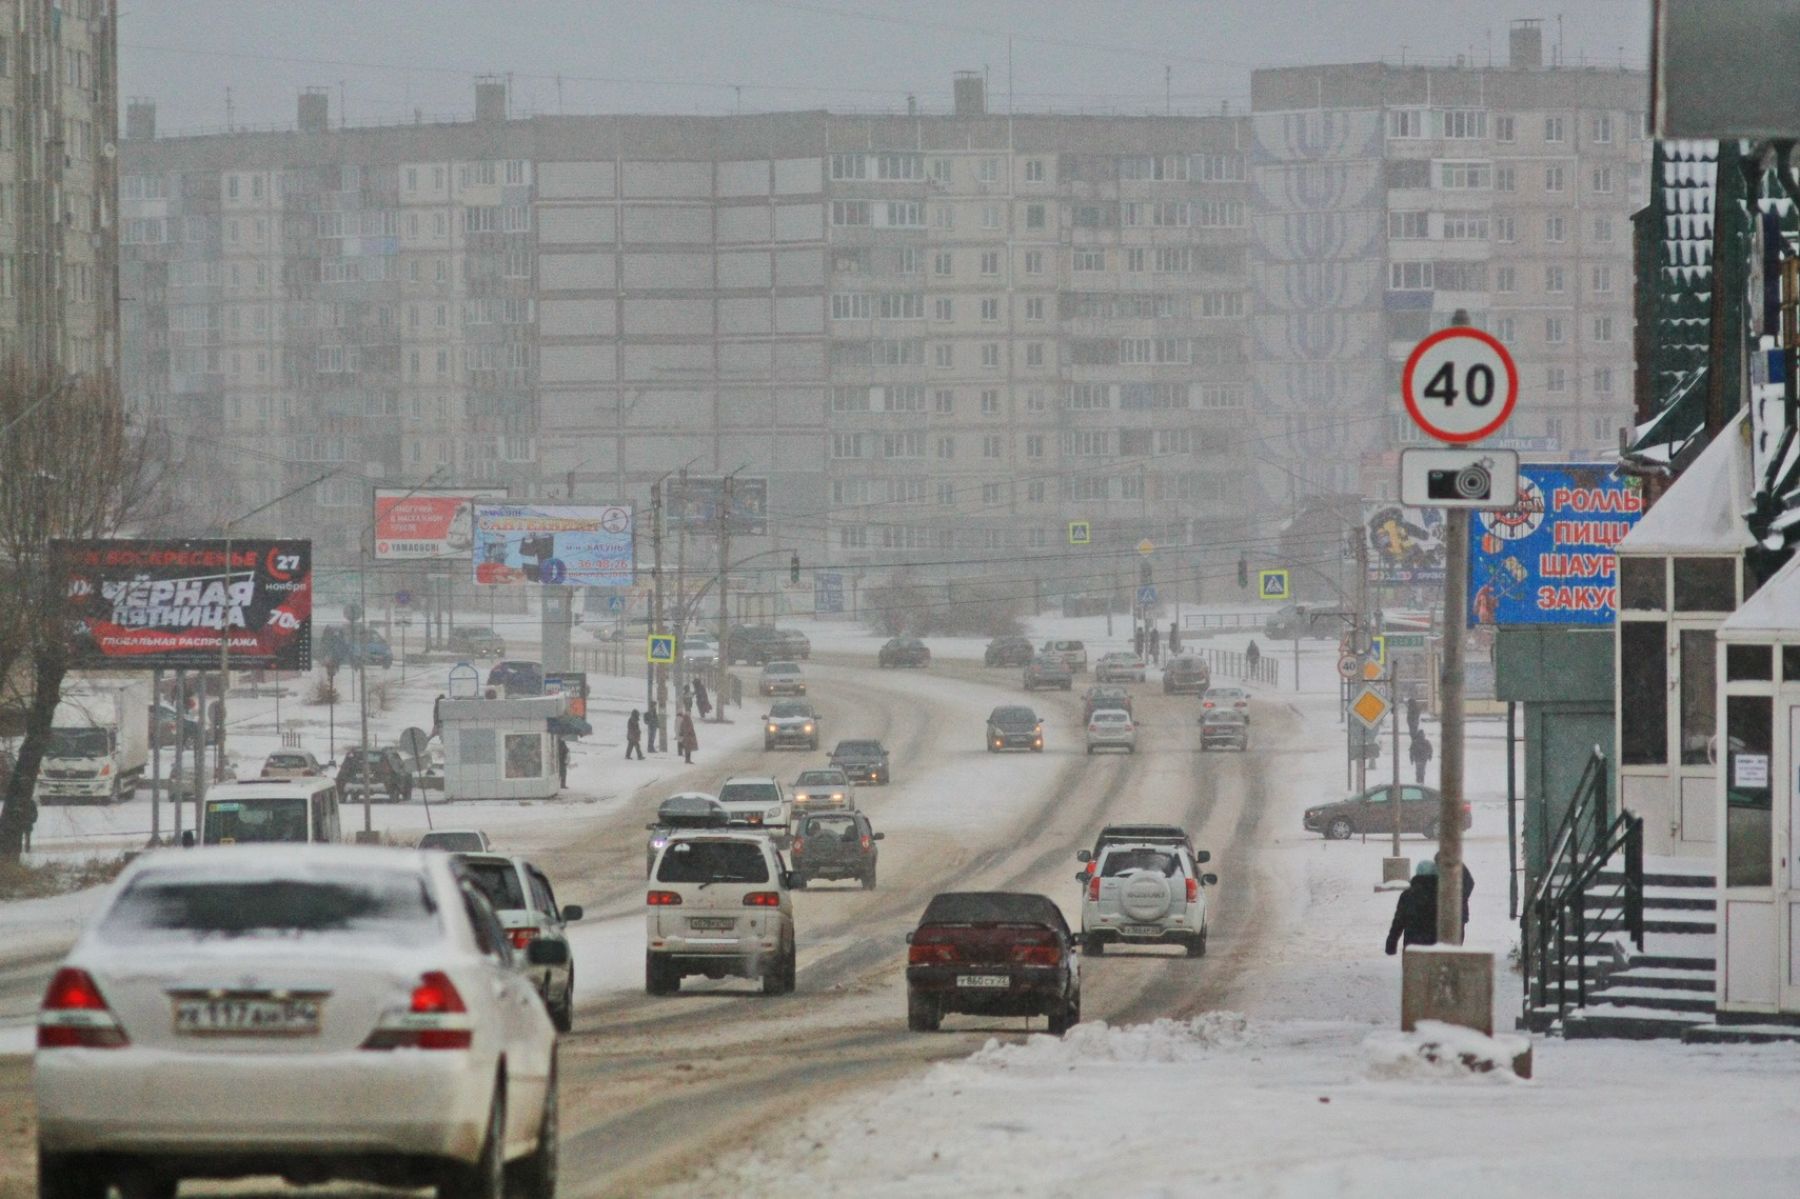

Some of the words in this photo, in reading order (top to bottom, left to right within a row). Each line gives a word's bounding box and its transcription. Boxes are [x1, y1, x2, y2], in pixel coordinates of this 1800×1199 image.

[1424, 361, 1494, 407] 40
[1553, 521, 1631, 547] ПИЦЦ
[276, 555, 300, 571] 27
[1540, 554, 1616, 577] ШАУР
[101, 574, 255, 606] ЧЁРНАЯ
[265, 582, 307, 593] ноября
[111, 605, 246, 629] ПЯТНИЦА
[267, 609, 300, 629] 70%
[102, 637, 176, 647] ГЛОБАЛЬНАЯ
[1343, 661, 1356, 671] 40
